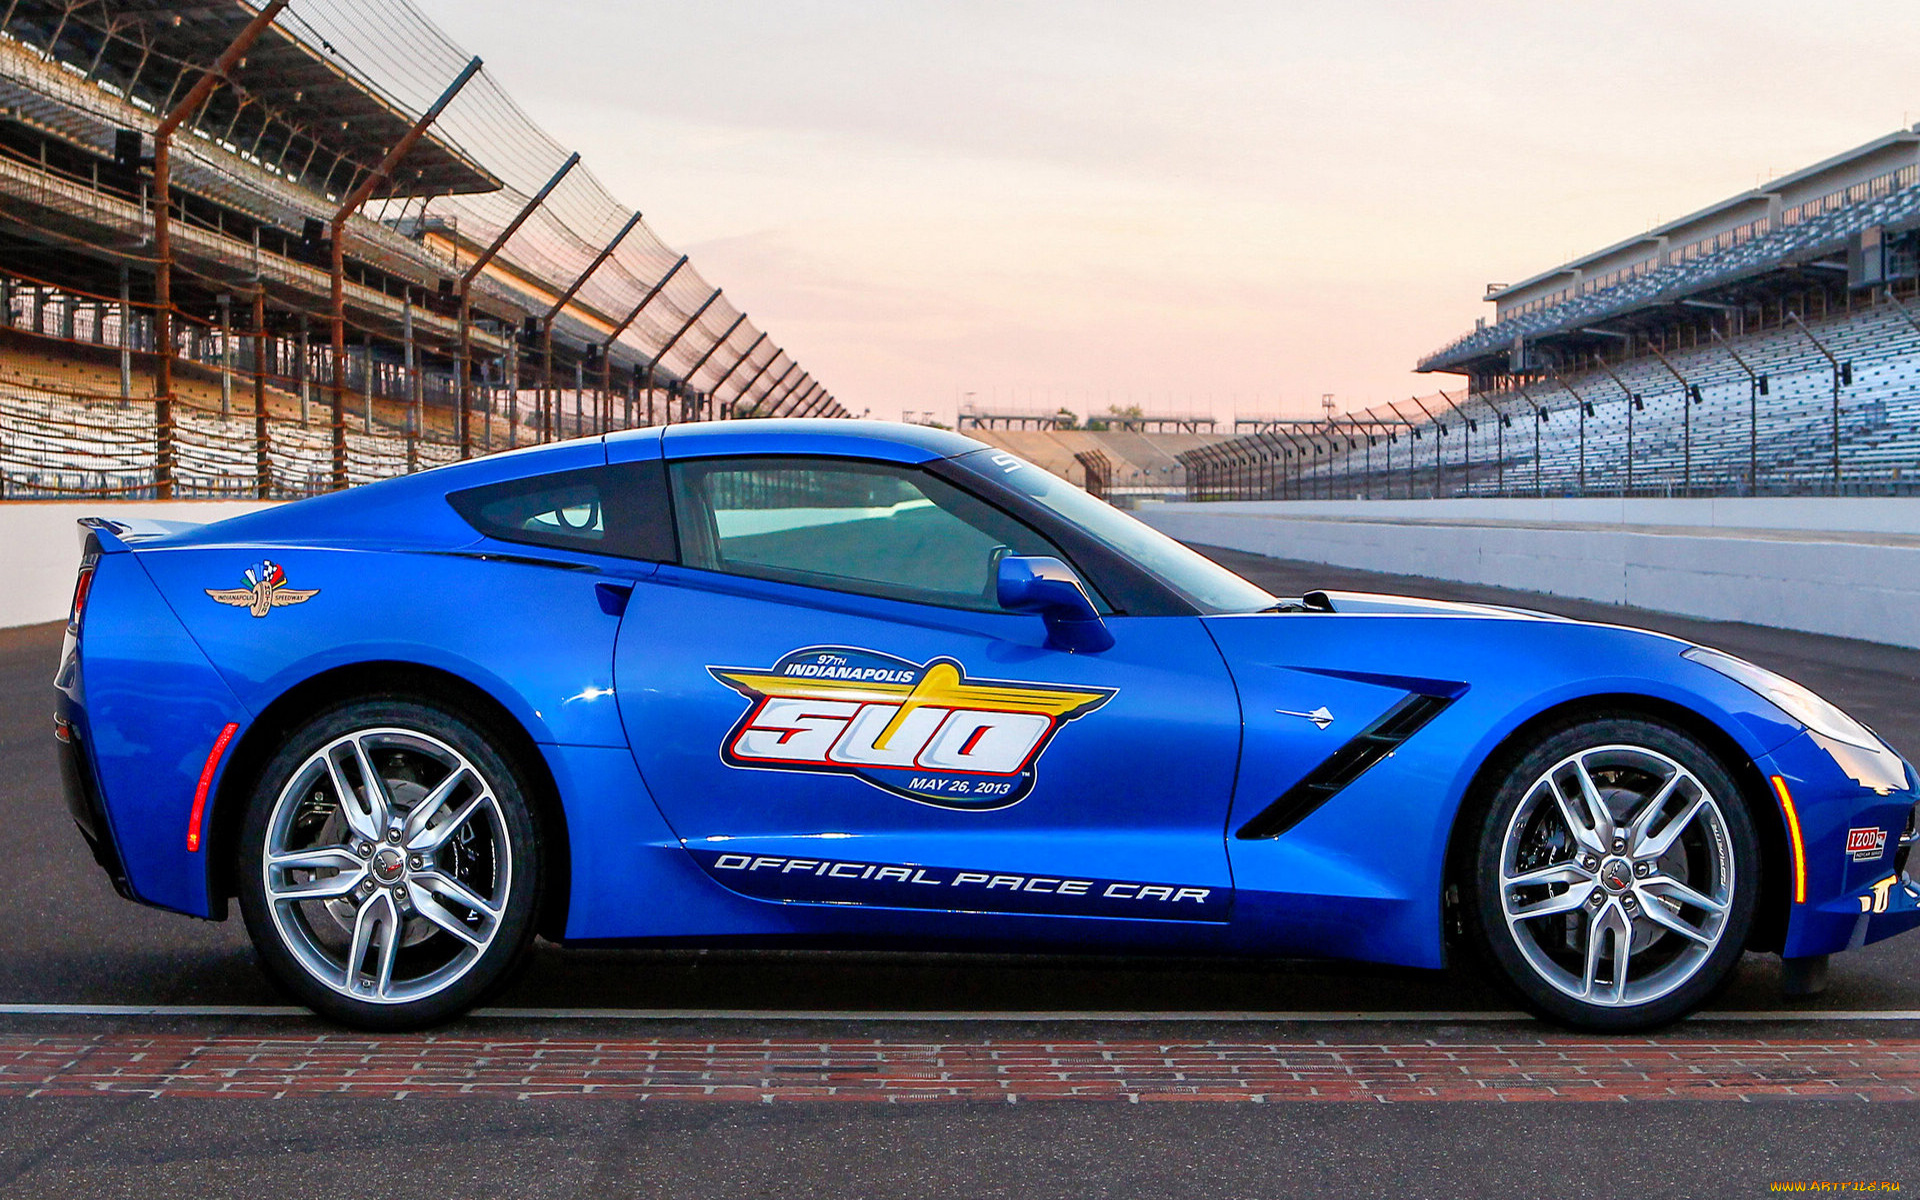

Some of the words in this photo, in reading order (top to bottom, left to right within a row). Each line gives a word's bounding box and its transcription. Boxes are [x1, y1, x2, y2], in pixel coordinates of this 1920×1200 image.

[261, 585, 271, 613] MOTOR
[817, 654, 847, 666] 97TH
[784, 663, 915, 683] INDIANAPOLIS
[731, 696, 1055, 774] 500
[908, 777, 949, 791] MAY
[948, 780, 971, 794] 26,
[974, 782, 1011, 795] 2013
[1850, 831, 1876, 848] IZOD
[713, 854, 942, 885] OFFICIAL
[951, 872, 1094, 896] PACE
[1103, 883, 1211, 904] CAR
